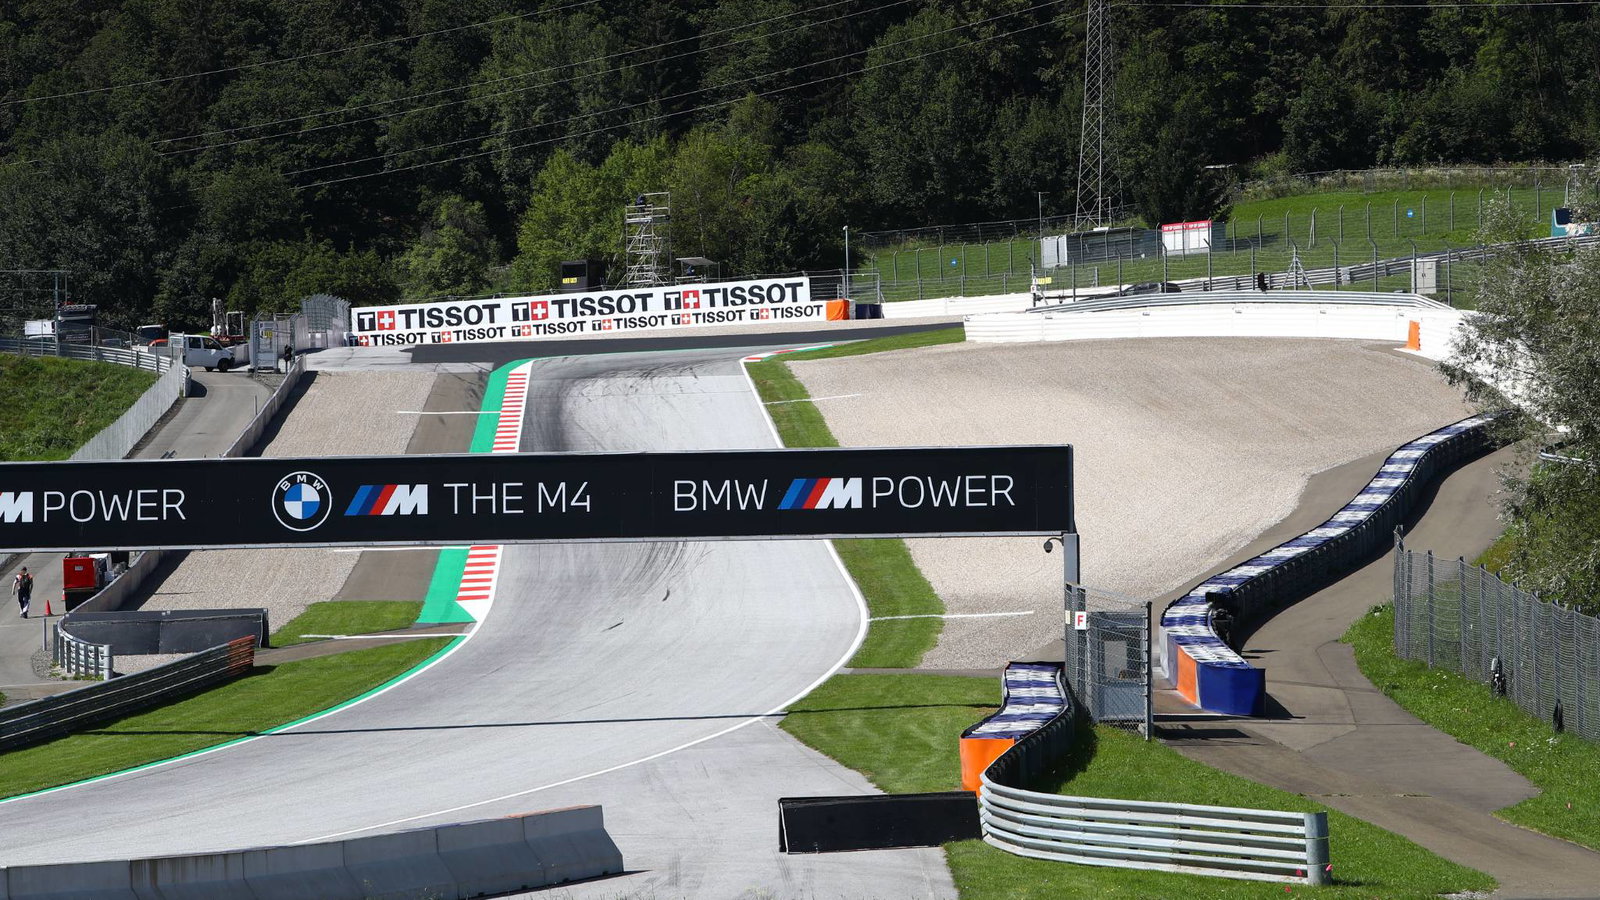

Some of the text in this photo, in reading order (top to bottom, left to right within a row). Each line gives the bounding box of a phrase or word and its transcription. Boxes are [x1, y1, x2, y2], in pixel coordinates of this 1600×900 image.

[398, 304, 501, 329] TISSOT
[551, 293, 654, 318] TISSOT
[703, 282, 804, 307] TISSOT
[370, 332, 426, 346] TISSOT
[453, 327, 506, 341] TISSOT
[533, 321, 586, 335] TISSOT
[613, 315, 667, 329] TISSOT
[692, 310, 745, 323] TISSOT
[771, 305, 823, 318] TISSOT
[280, 474, 324, 491] BMW
[380, 481, 591, 516] M THE M4
[674, 474, 1016, 512] BMW M POWER
[0, 489, 187, 523] M POWER
[1077, 615, 1084, 626] F
